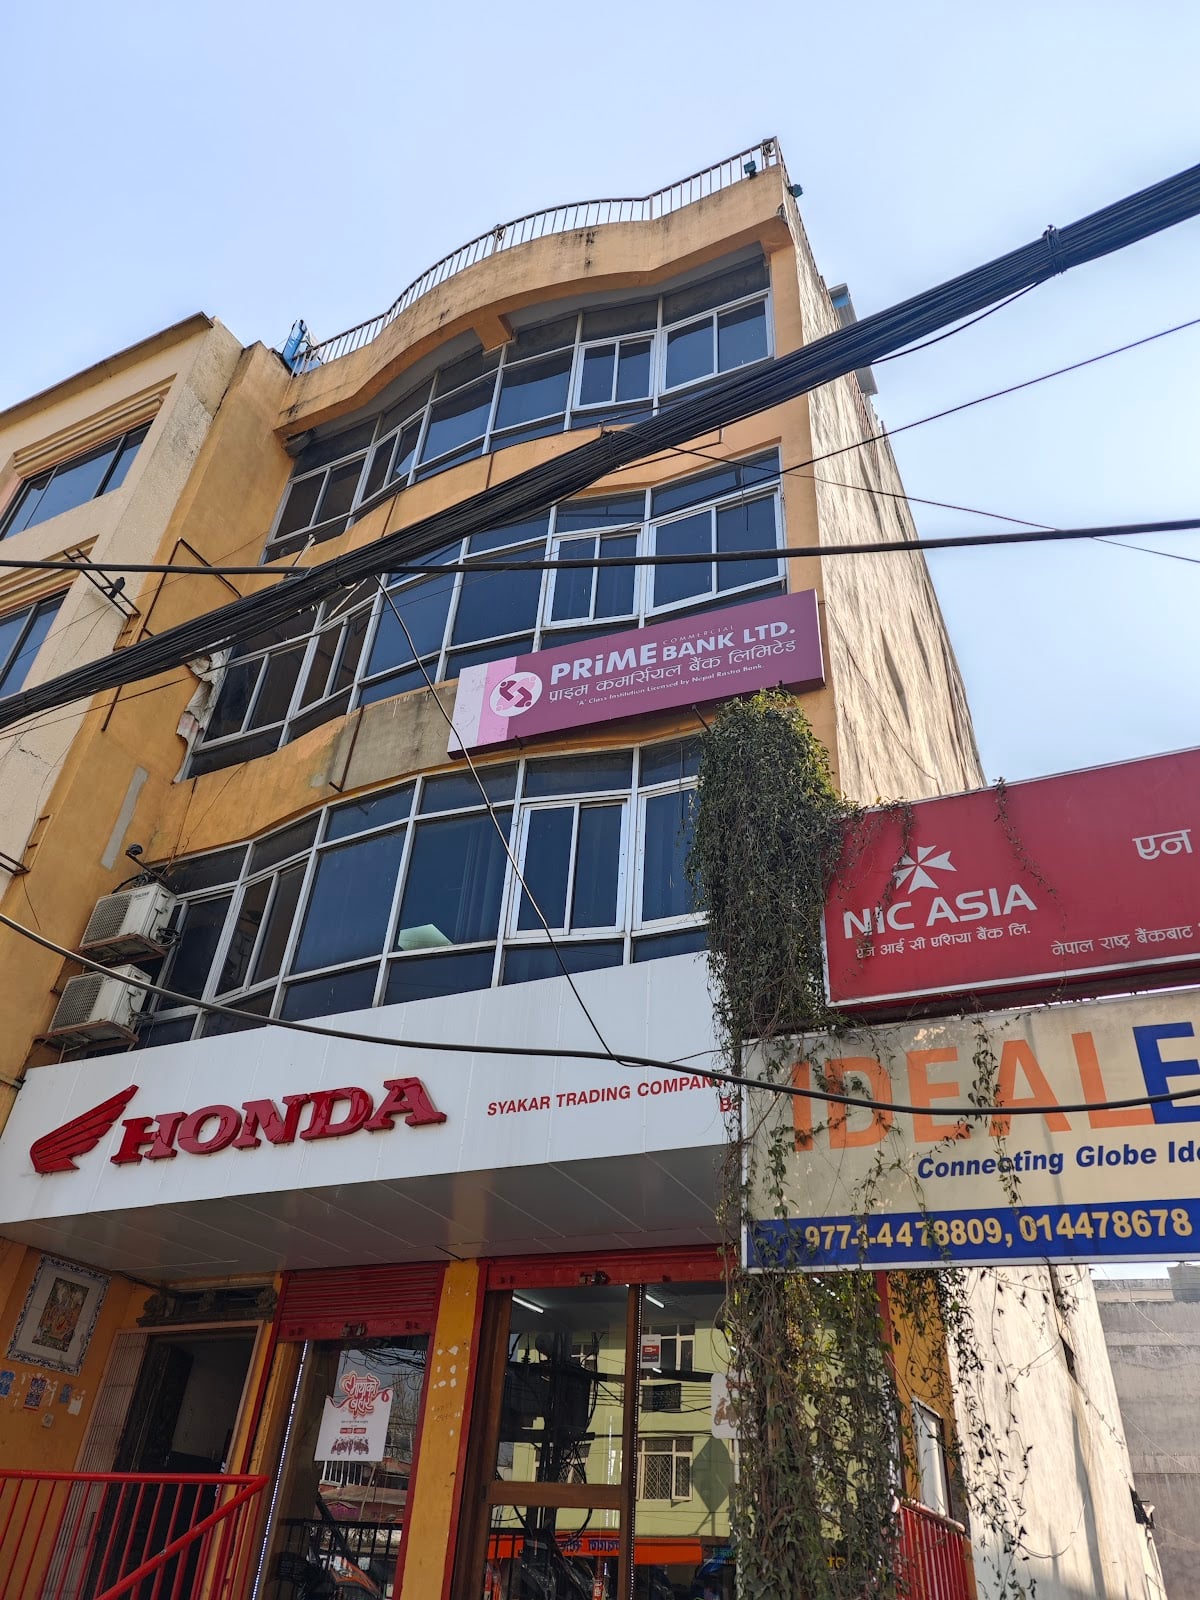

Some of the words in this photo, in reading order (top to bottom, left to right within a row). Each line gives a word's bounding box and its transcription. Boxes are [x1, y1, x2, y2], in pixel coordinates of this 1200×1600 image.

[662, 632, 735, 661] BANK
[743, 621, 796, 644] LTD.
[548, 684, 589, 703] प्राइम
[596, 665, 682, 692] कमर्सियल
[689, 656, 722, 672] बैंक
[728, 640, 797, 665] लिमिटेड
[589, 696, 607, 705] Class
[609, 688, 645, 700] Institution
[647, 679, 679, 692] Licensed
[680, 678, 689, 686] by
[692, 674, 714, 683] Nepal
[1132, 829, 1193, 860] एन
[842, 901, 915, 939] NIC
[926, 884, 1038, 927] ASIA
[880, 939, 905, 955] आई
[909, 938, 926, 951] सी
[976, 926, 1003, 940] बैंक
[1008, 922, 1031, 937] लि.
[1051, 940, 1094, 956] नेपाल
[1098, 934, 1131, 950] राष्ट्र
[1135, 927, 1193, 944] बैंकबाट
[487, 1095, 551, 1116] SYAKAR
[556, 1085, 631, 1108] TRADING
[110, 1077, 447, 1166] HONDA
[917, 1150, 1064, 1179] Connecting
[1076, 1144, 1158, 1168] Globe
[1168, 1141, 1200, 1164] Id
[1019, 1207, 1193, 1243] 014478678
